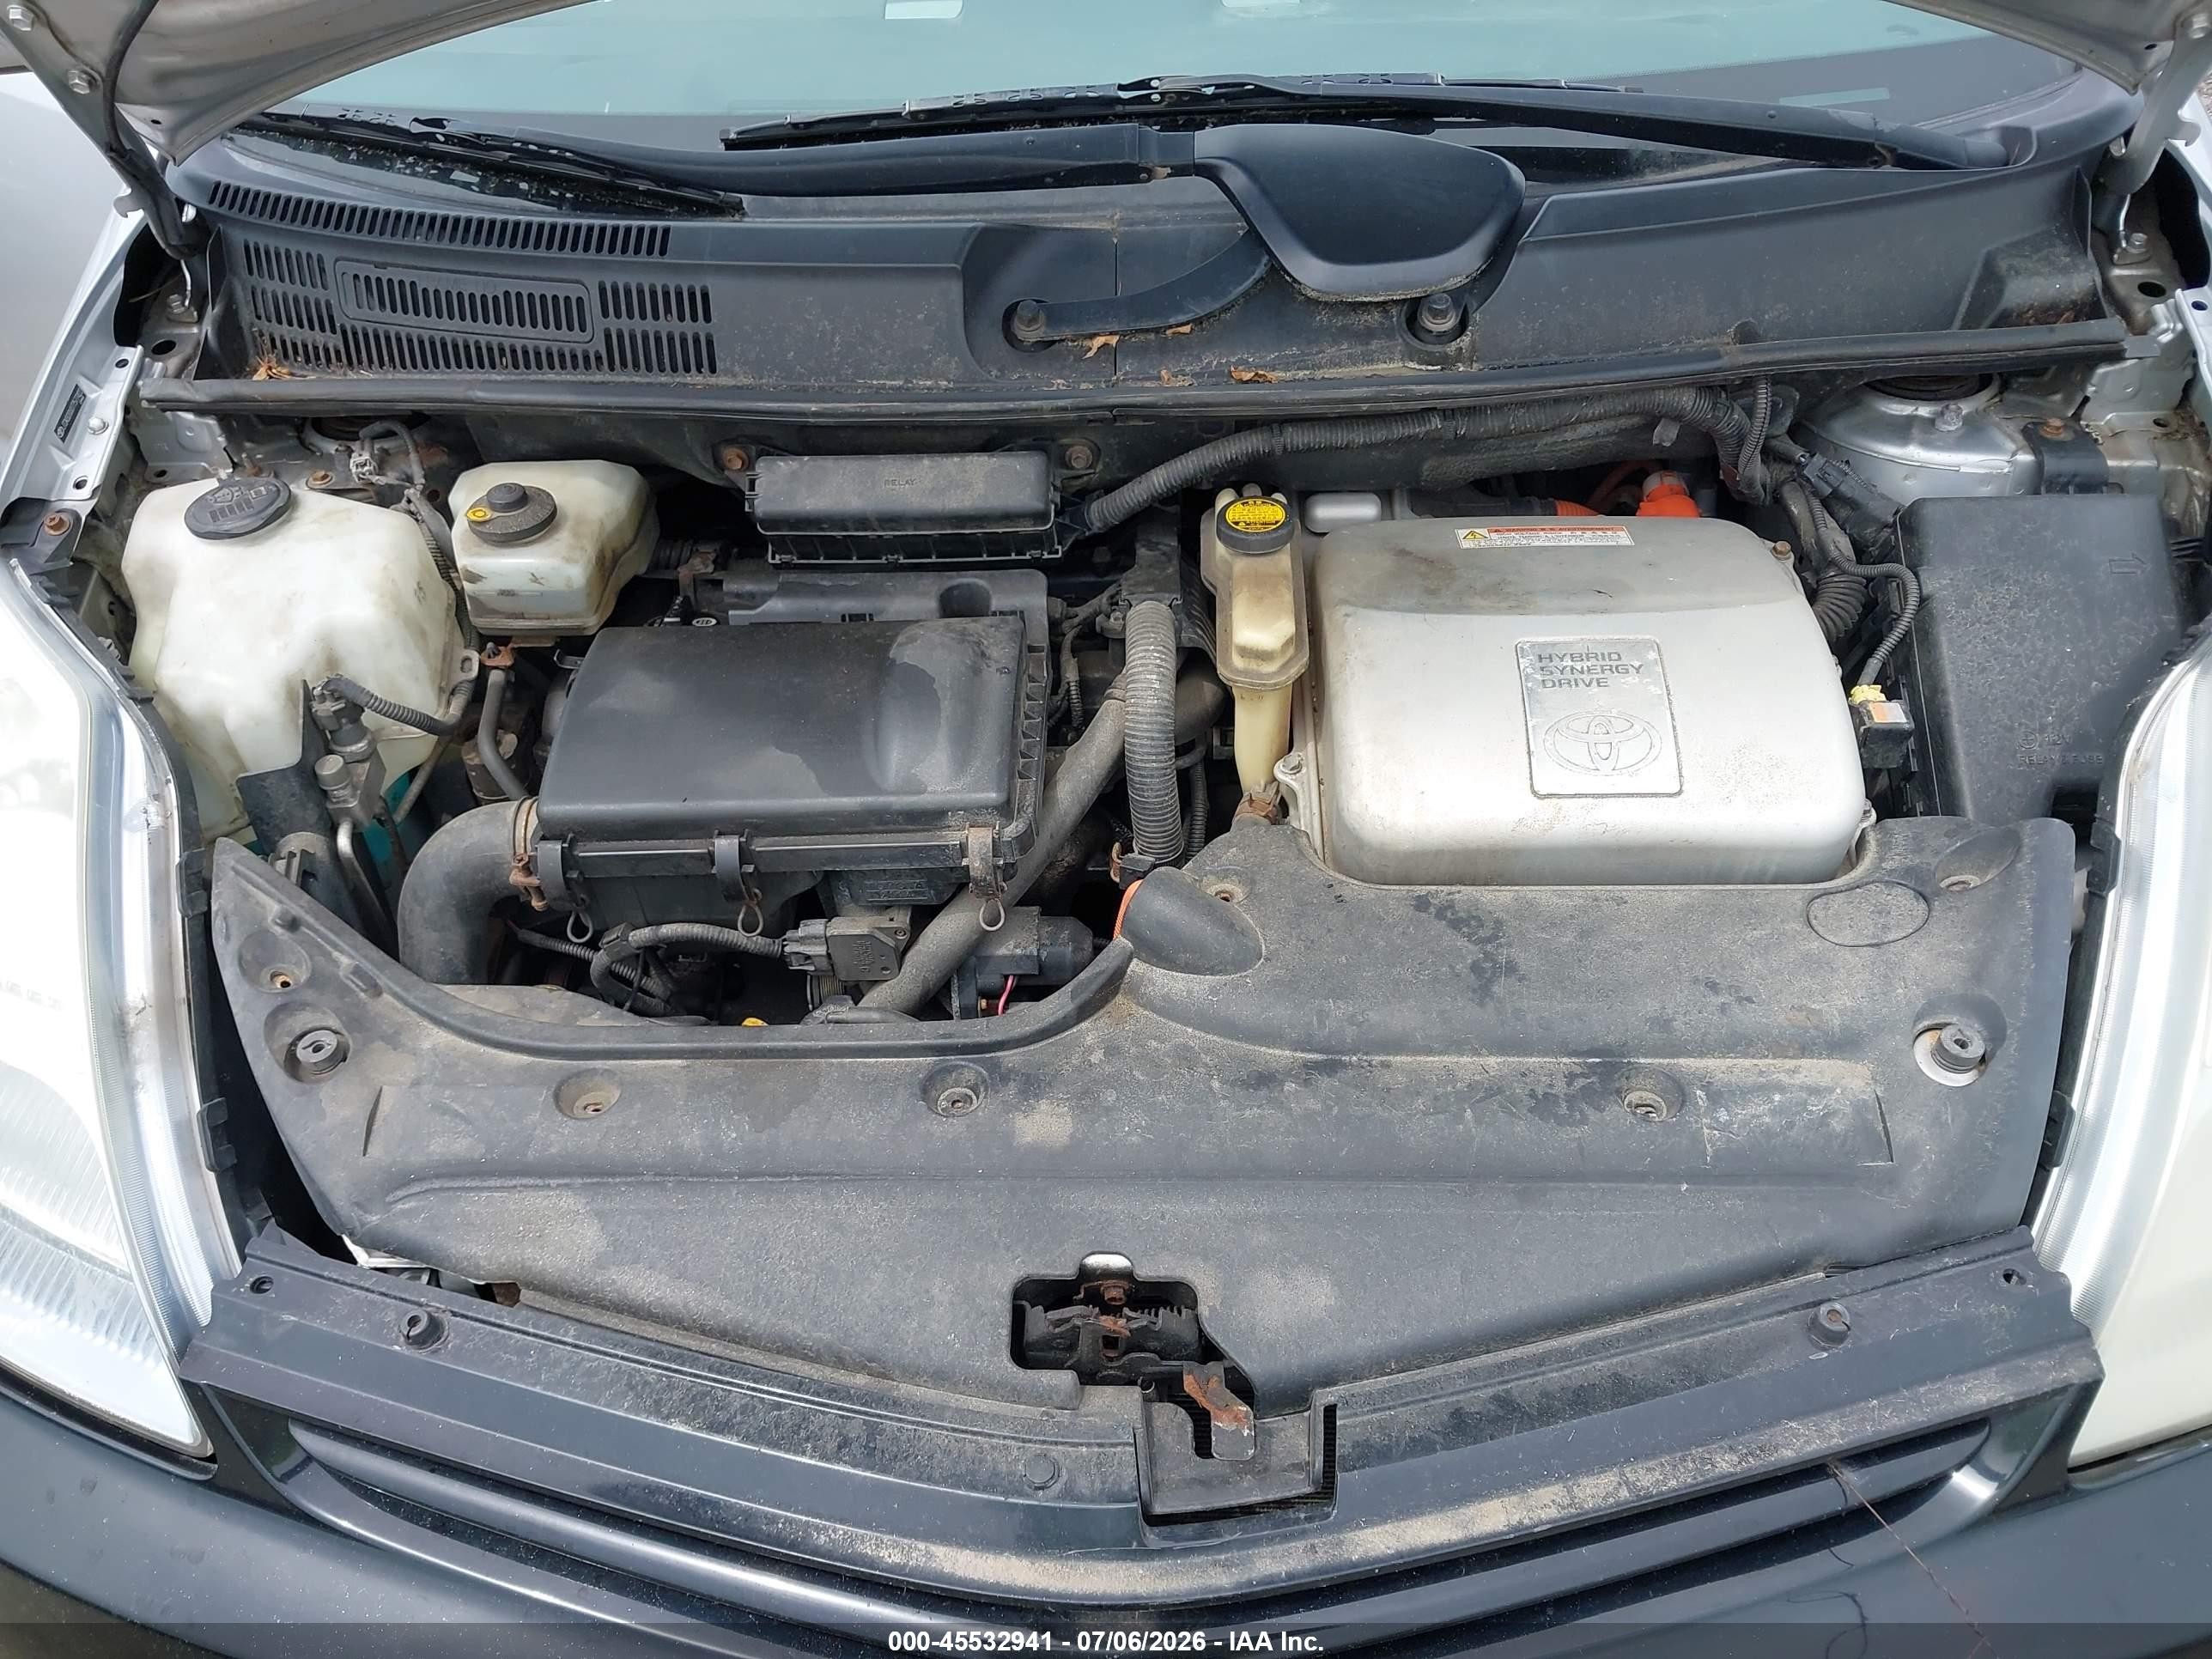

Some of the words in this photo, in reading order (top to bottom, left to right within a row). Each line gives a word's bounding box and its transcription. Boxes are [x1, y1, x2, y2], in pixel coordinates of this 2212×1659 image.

[1538, 651, 1622, 663] HYBRID
[1539, 664, 1644, 677] SYNERGY
[1540, 677, 1609, 689] DRIVE
